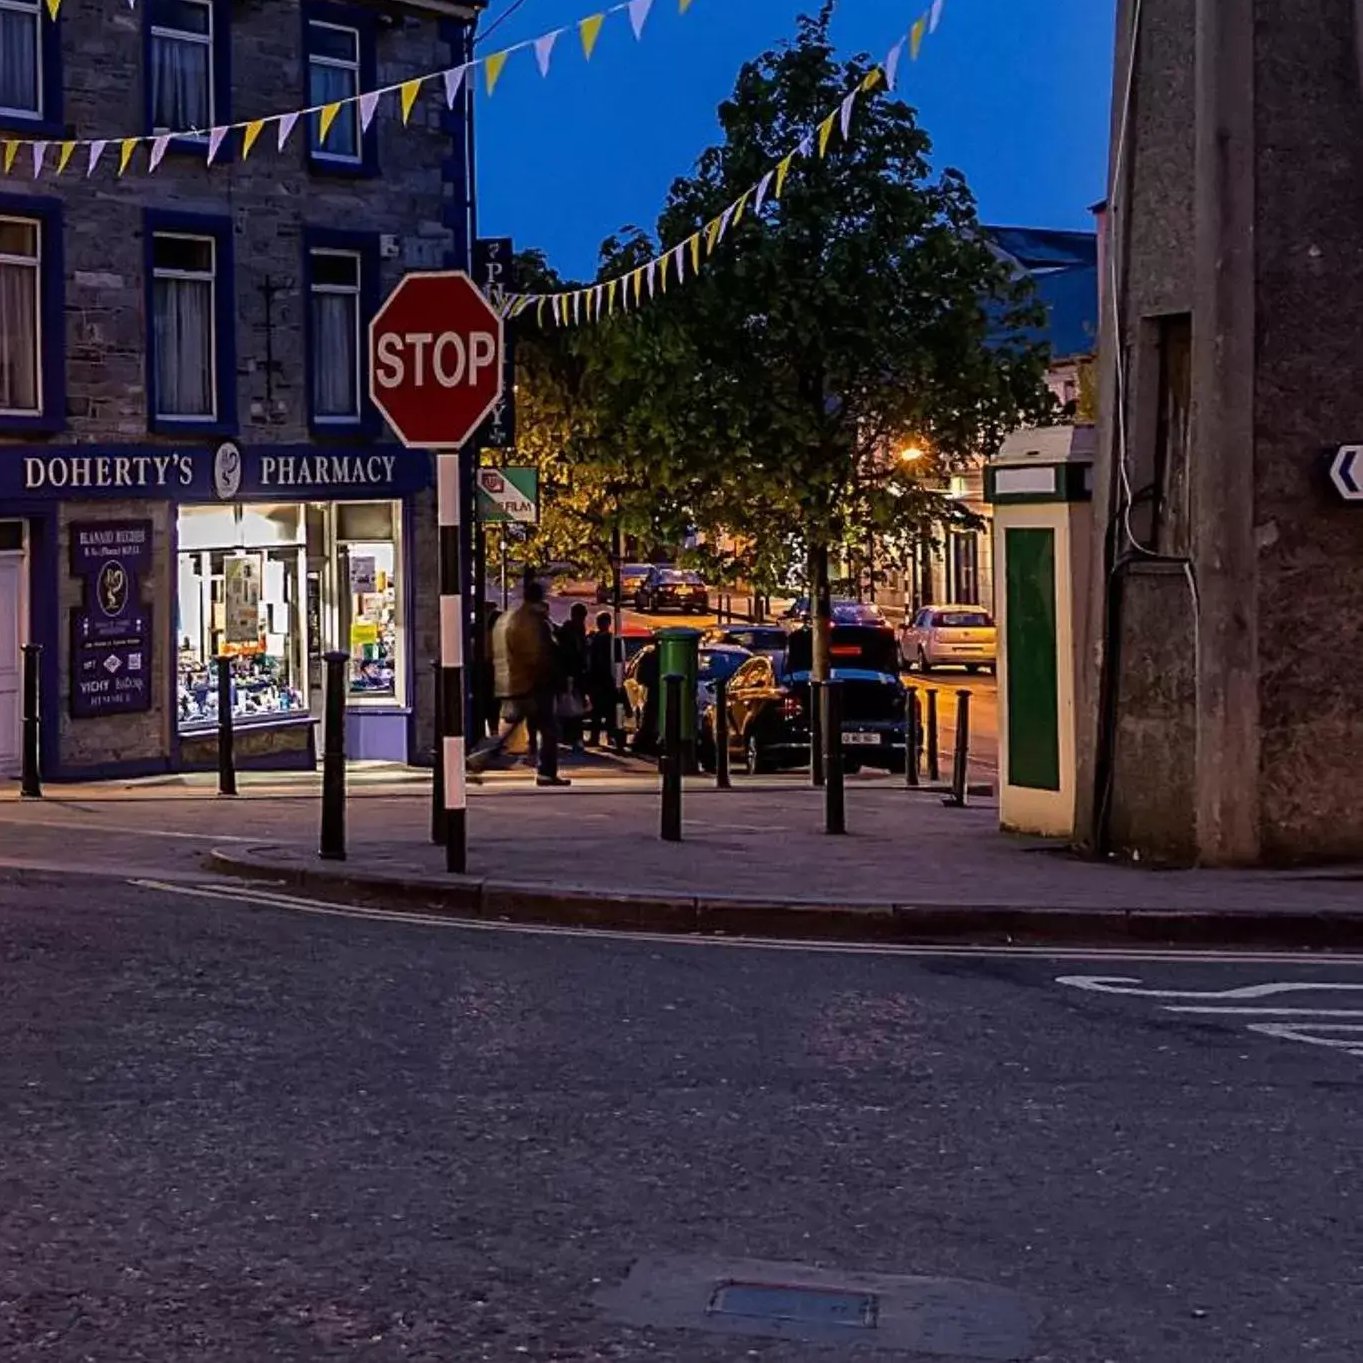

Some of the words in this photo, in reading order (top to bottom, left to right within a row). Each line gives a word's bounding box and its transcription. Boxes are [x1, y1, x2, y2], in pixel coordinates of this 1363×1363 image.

[376, 330, 496, 388] STOP
[24, 453, 193, 489] DOHERTY'S
[260, 455, 397, 485] PHARMACY
